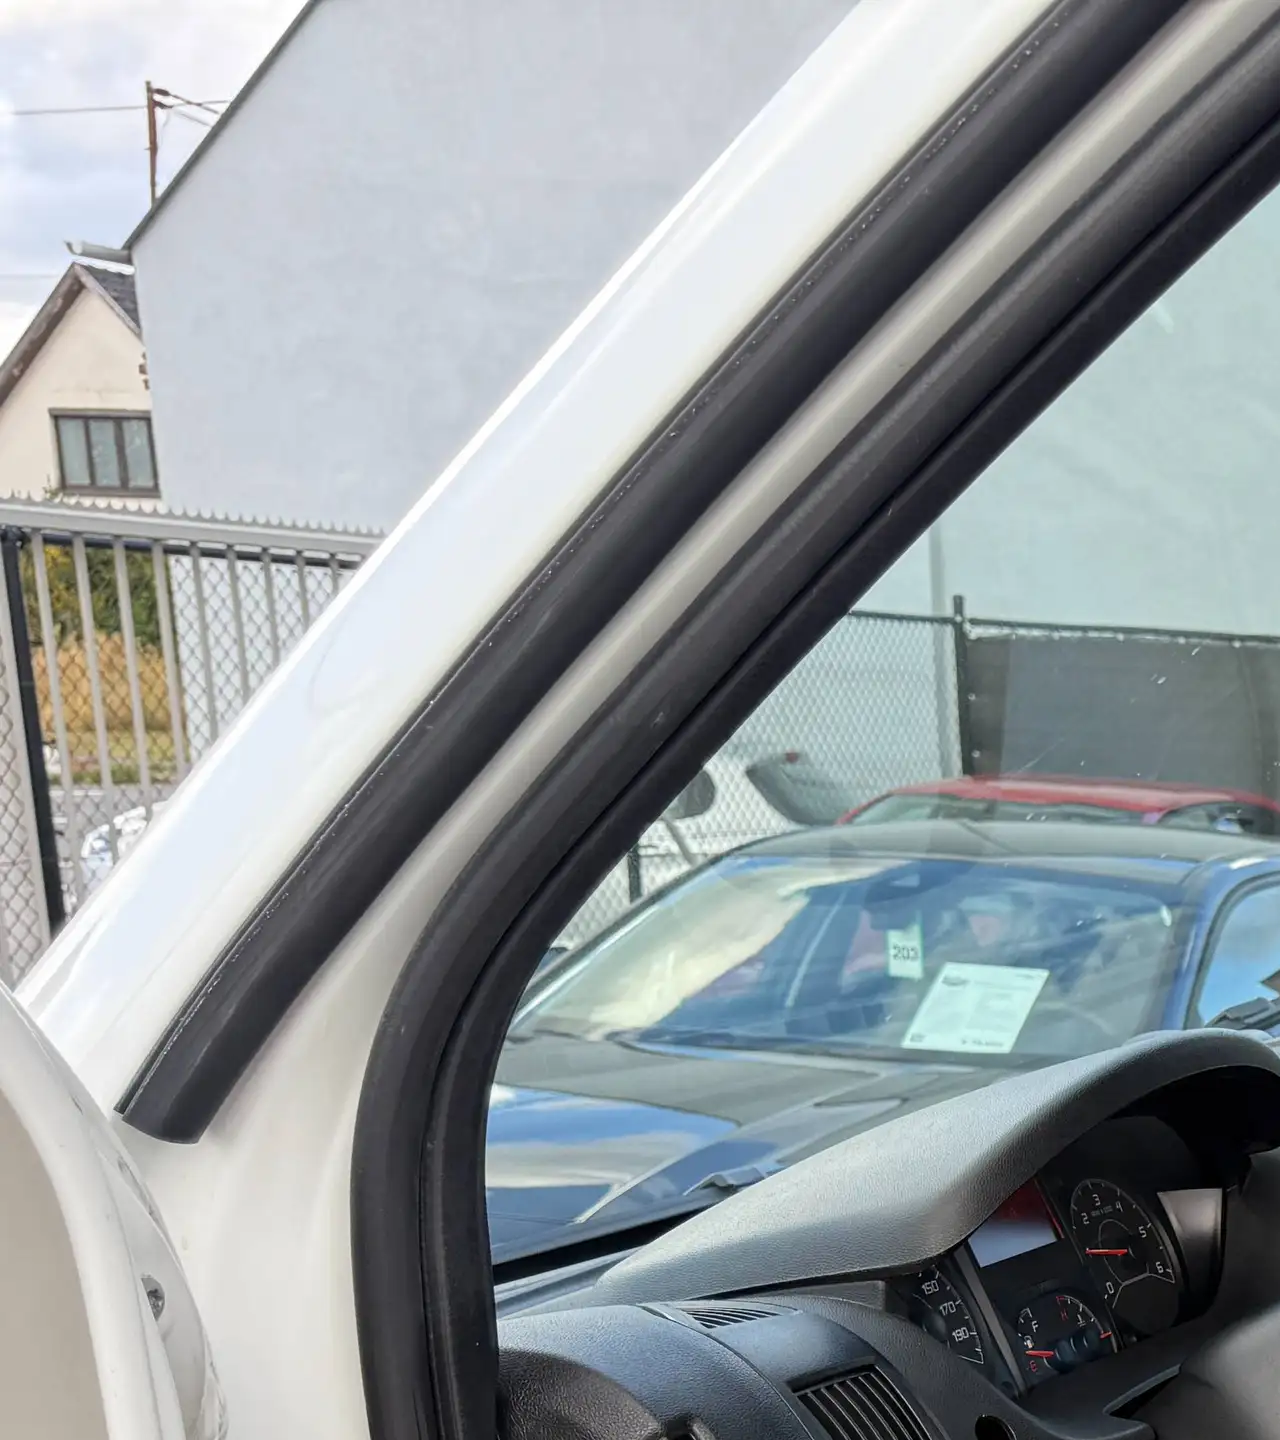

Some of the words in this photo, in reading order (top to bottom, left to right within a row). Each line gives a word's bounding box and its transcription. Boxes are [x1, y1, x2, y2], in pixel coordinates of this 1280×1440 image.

[1092, 1194, 1101, 1206] 3
[1081, 1212, 1090, 1225] 2
[1138, 1226, 1147, 1238] 5
[1155, 1261, 1164, 1273] 6
[921, 1280, 940, 1295] 150
[940, 1301, 957, 1316] 170
[1031, 1320, 1039, 1333] F
[952, 1326, 970, 1342] 190
